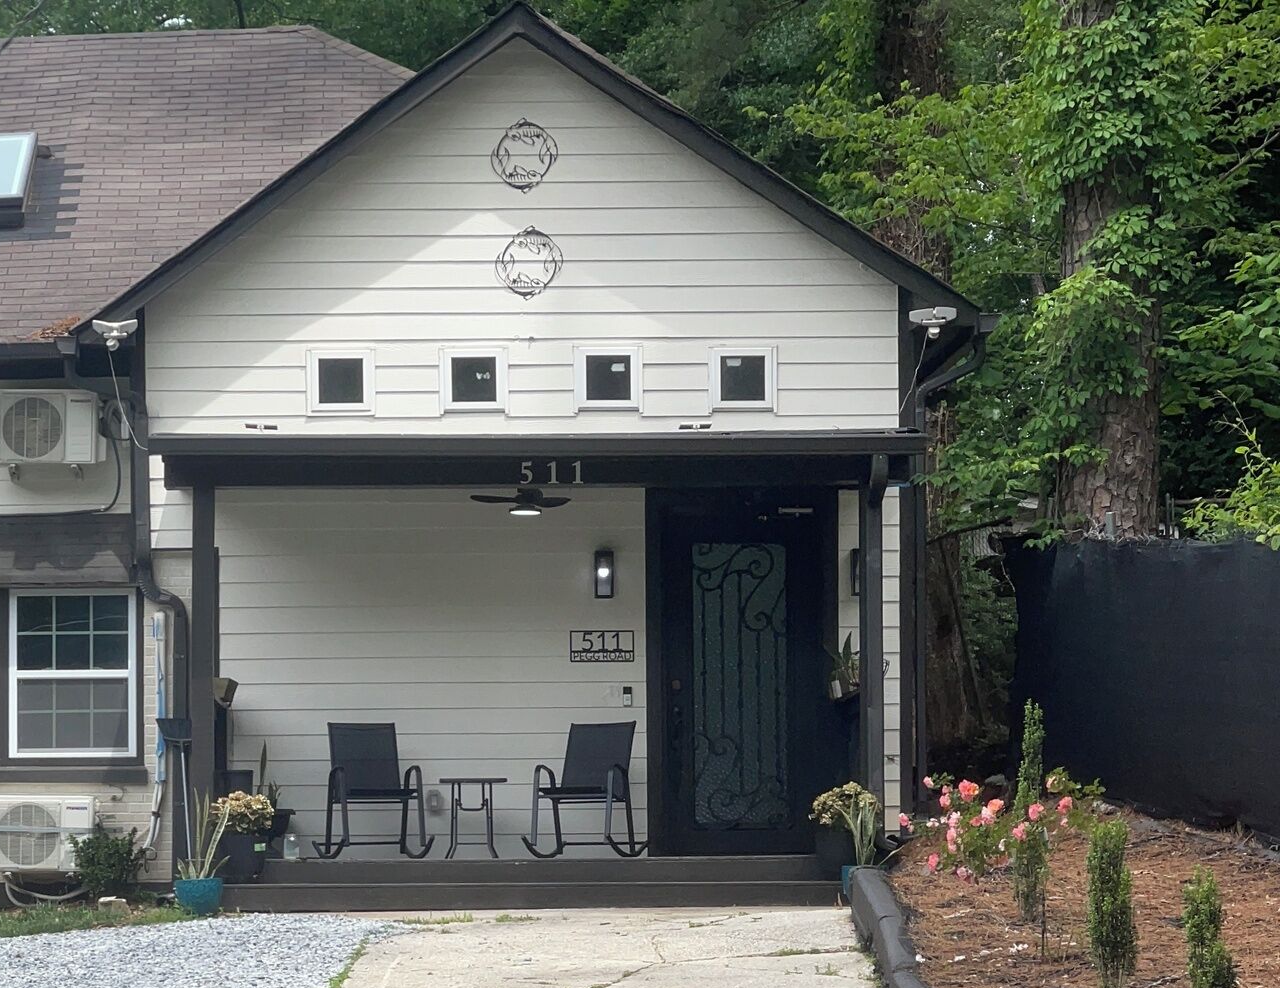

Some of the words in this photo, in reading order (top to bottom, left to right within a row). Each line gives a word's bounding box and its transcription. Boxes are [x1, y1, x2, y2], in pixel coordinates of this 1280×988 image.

[520, 461, 584, 484] 511
[581, 632, 623, 652] 511
[573, 652, 601, 661] PEGG
[602, 652, 632, 661] ROAD
